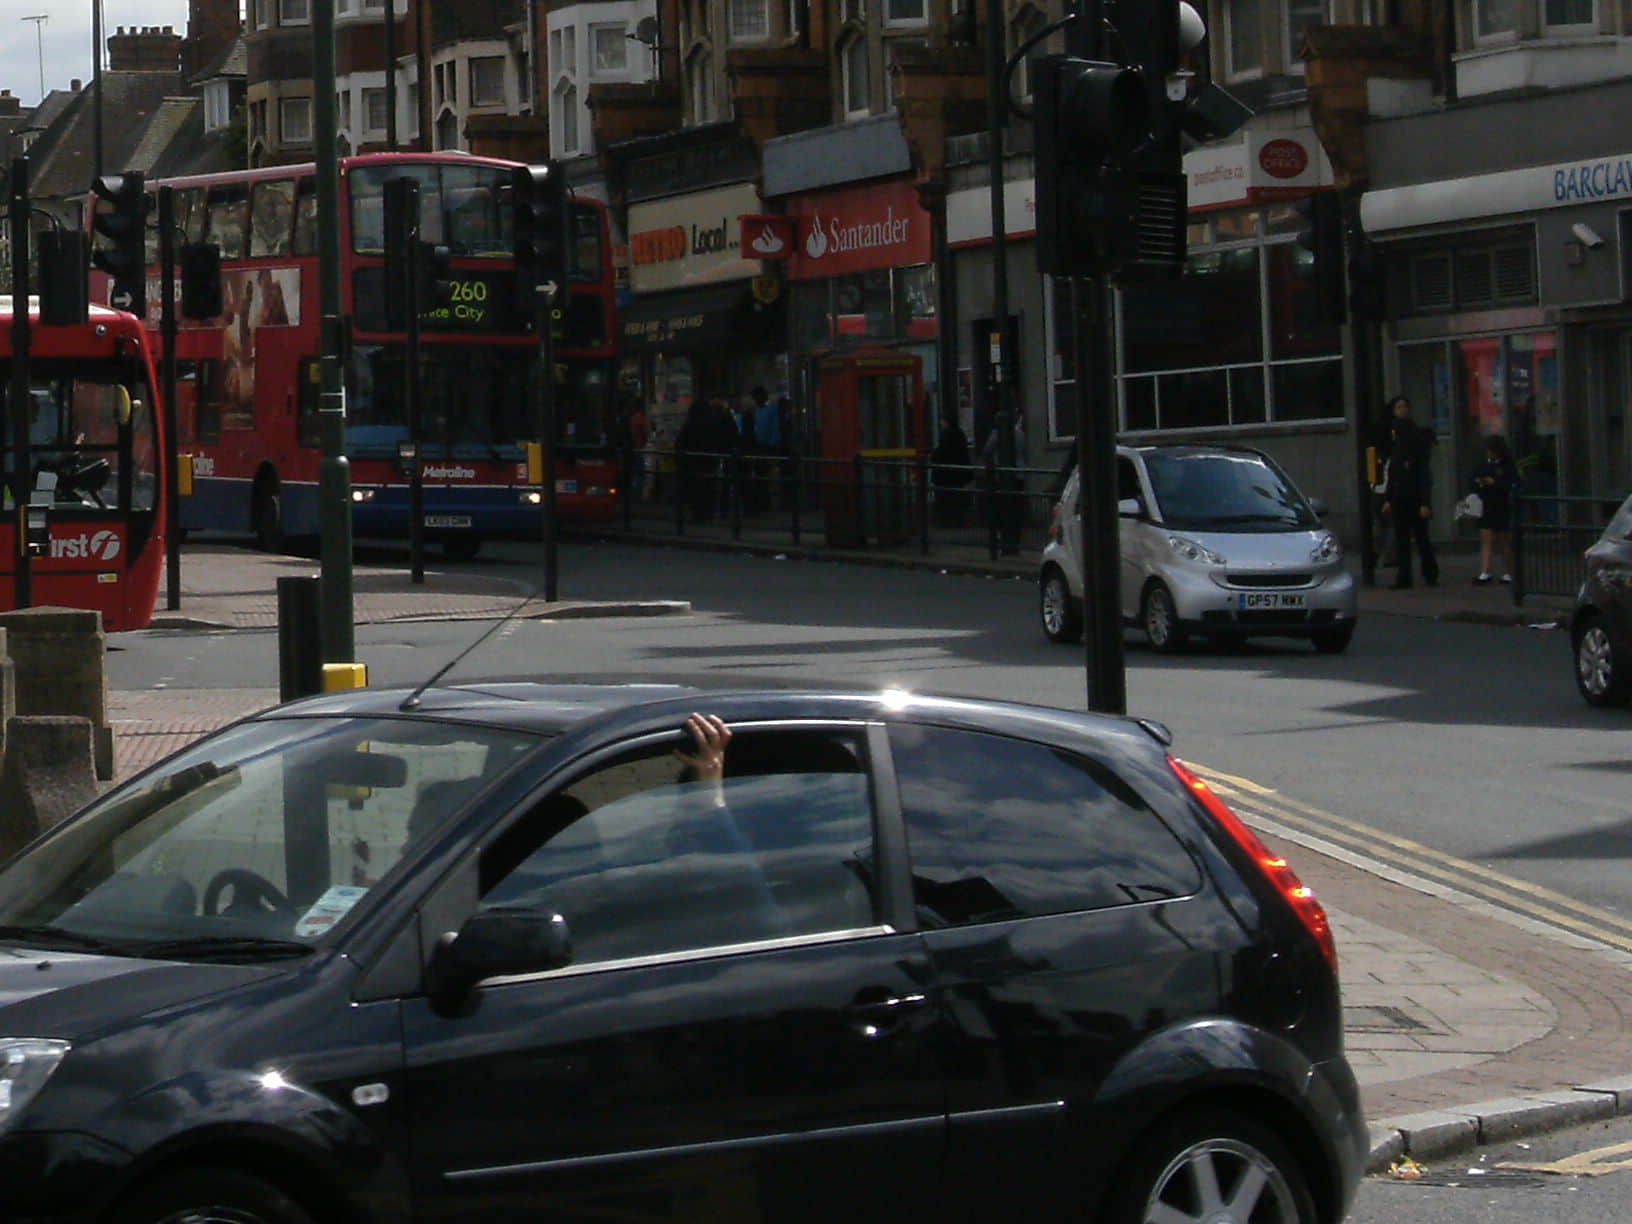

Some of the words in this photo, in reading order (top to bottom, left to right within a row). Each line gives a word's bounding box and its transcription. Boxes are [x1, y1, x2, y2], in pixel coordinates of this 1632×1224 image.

[830, 206, 909, 254] Santander
[449, 280, 486, 301] 260
[455, 304, 485, 322] City
[422, 465, 476, 479] Metroline
[48, 532, 88, 558] irst
